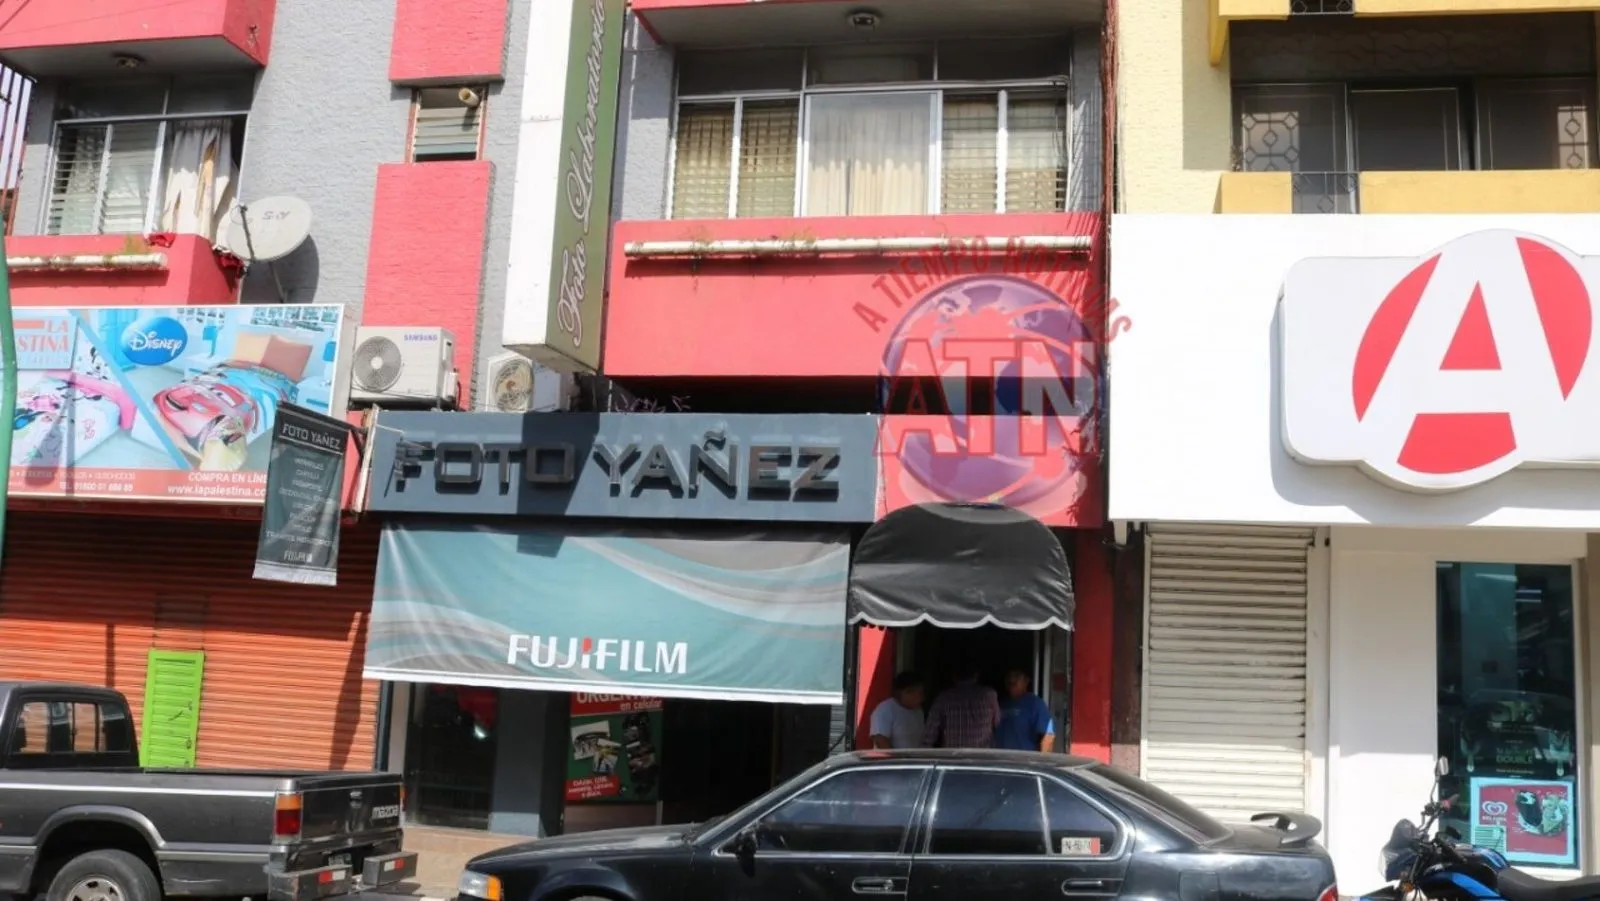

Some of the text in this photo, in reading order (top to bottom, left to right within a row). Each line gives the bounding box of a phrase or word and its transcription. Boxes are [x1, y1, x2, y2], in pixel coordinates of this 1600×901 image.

[557, 240, 585, 347] Foto
[17, 335, 69, 353] STINA
[1356, 237, 1575, 472] A
[282, 423, 341, 450] FOTO YAÑEZ
[188, 472, 268, 484] COMPRA EN LÍNE
[394, 425, 841, 499] FOTO YAÑEZ
[168, 484, 267, 497] www.lapalestina.co
[507, 634, 689, 674] FUJIFILM
